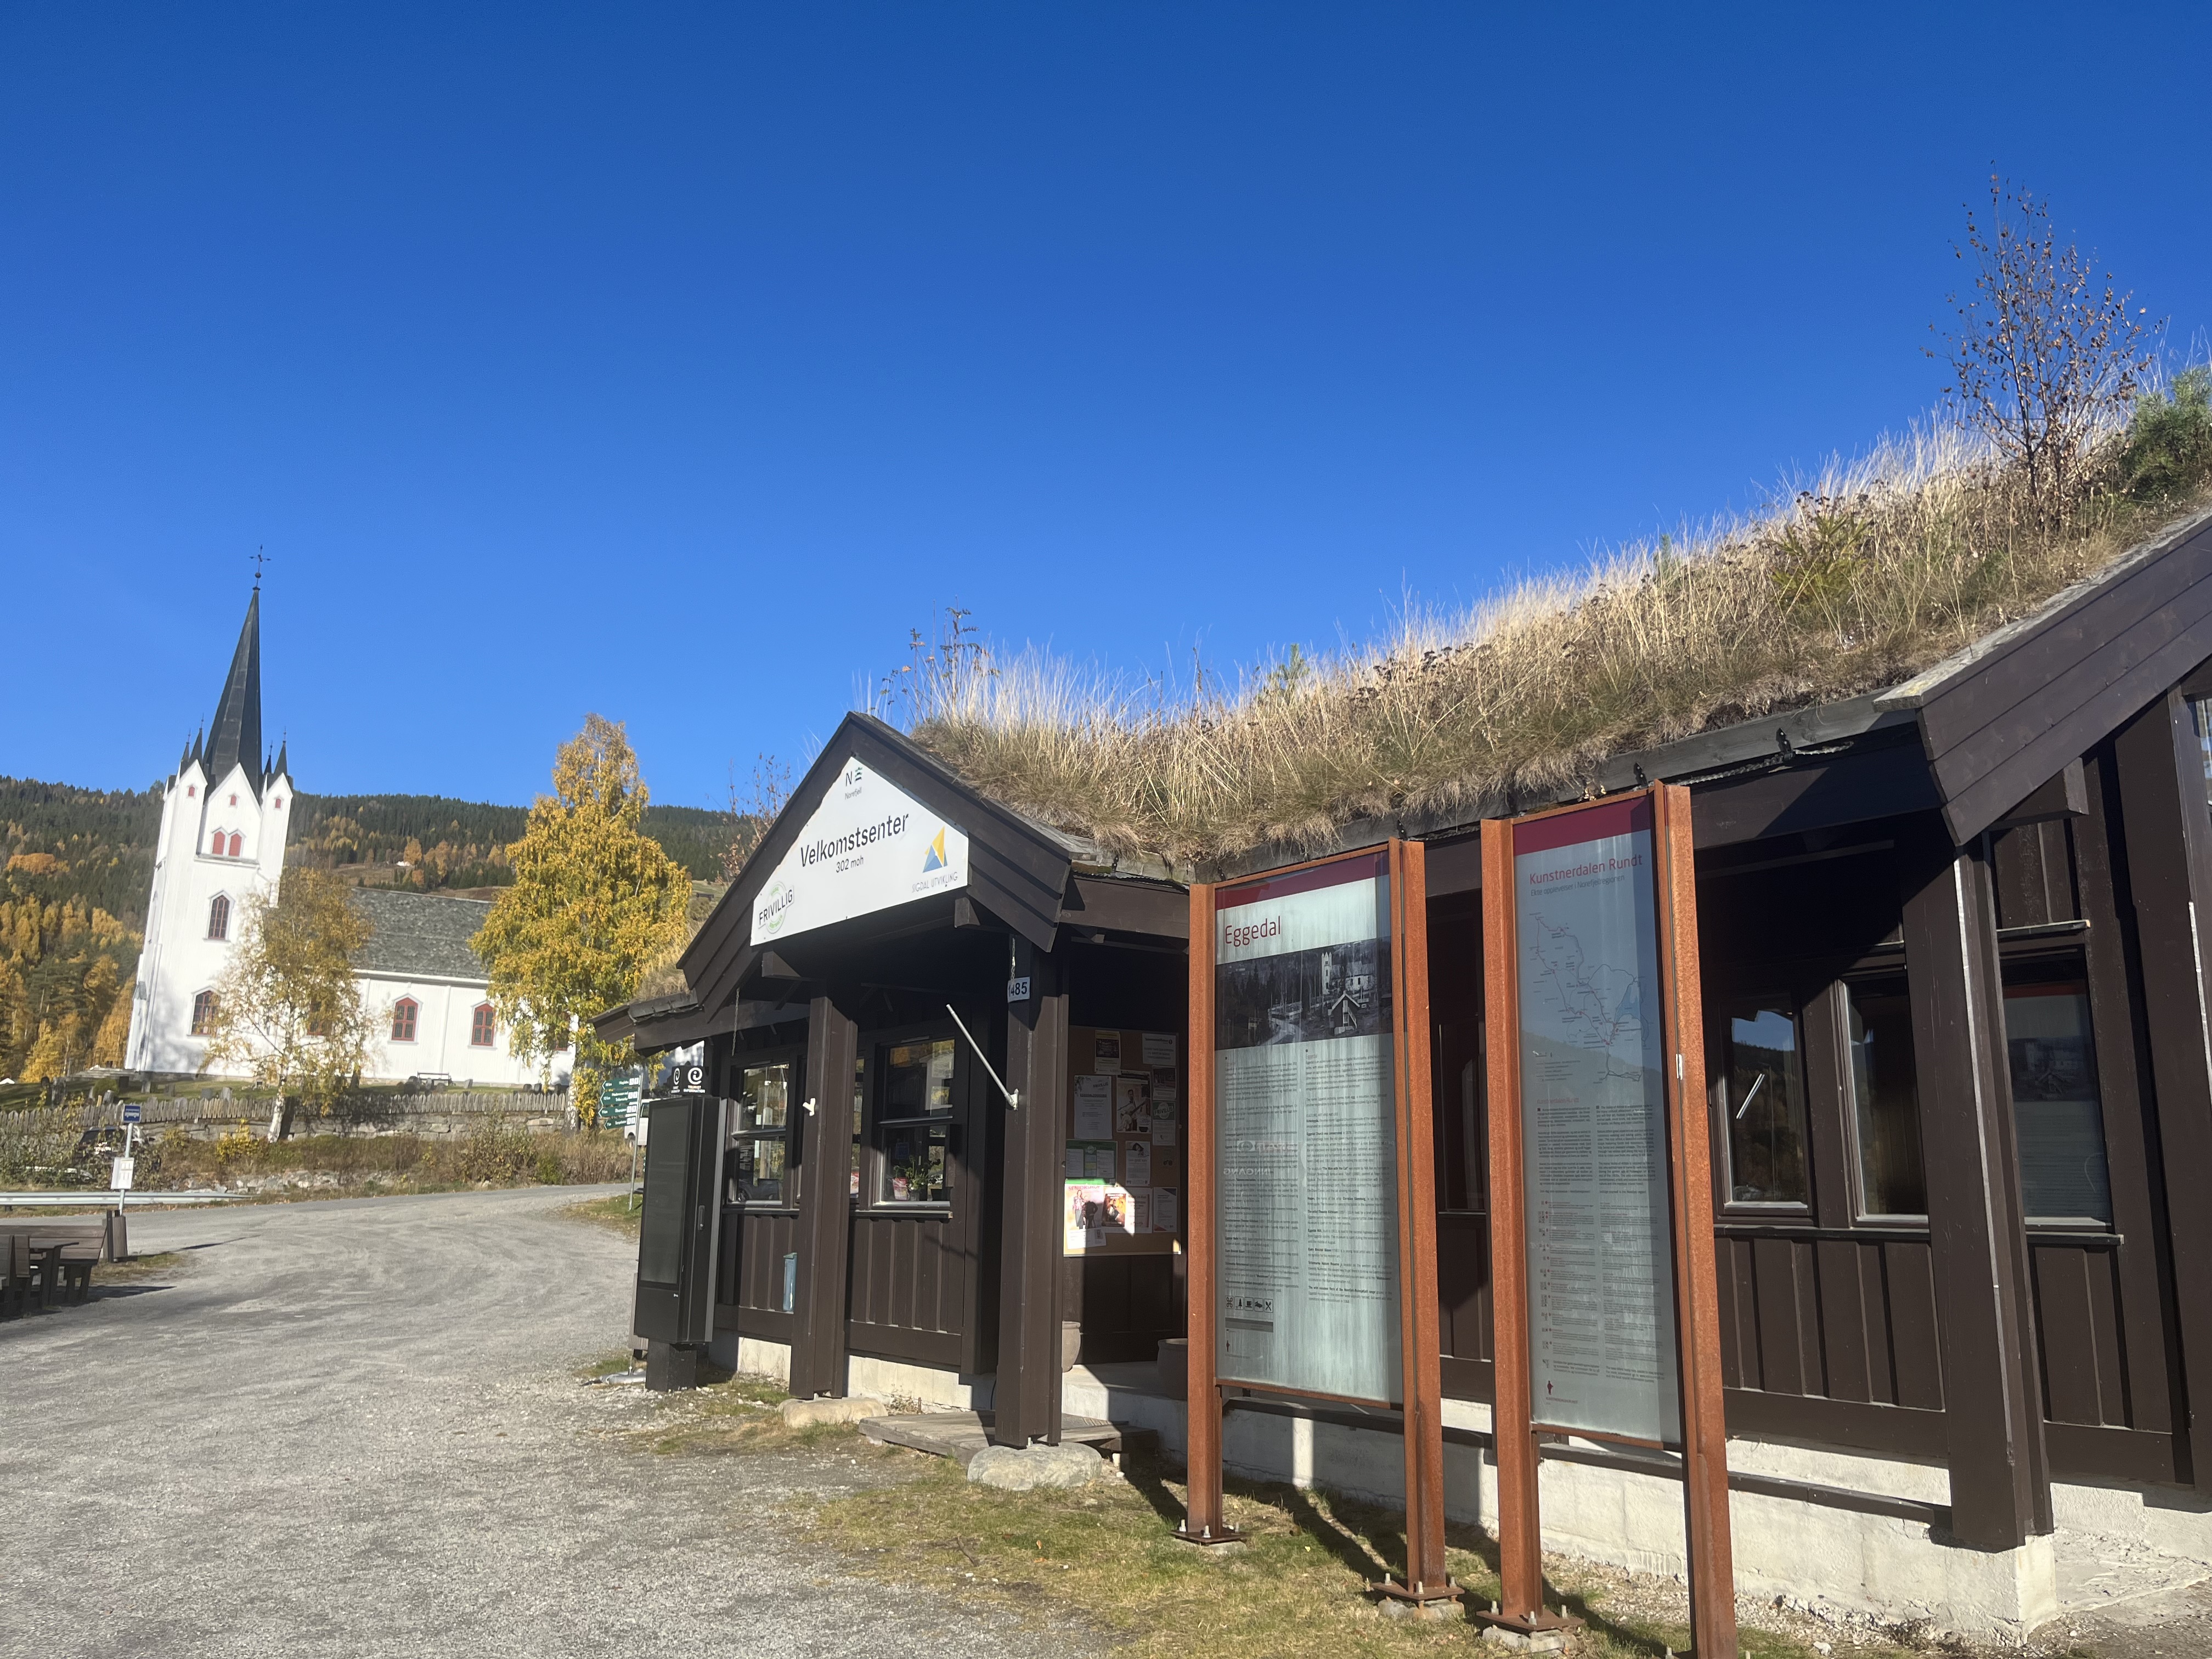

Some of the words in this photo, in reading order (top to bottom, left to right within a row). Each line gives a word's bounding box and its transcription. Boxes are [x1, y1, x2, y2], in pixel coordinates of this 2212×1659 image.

[800, 814, 909, 867] Velkomstsenter
[836, 860, 849, 873] 302
[850, 856, 864, 869] moh
[1530, 862, 1605, 885] Kunstnerdalen
[1609, 854, 1643, 870] Rundt
[912, 879, 929, 893] SIGDAL
[931, 872, 958, 888] UTVIKLING
[759, 889, 792, 926] FRIVILLIG
[1225, 915, 1281, 947] Eggedal
[1154, 1105, 1173, 1116] FRIVILLIG
